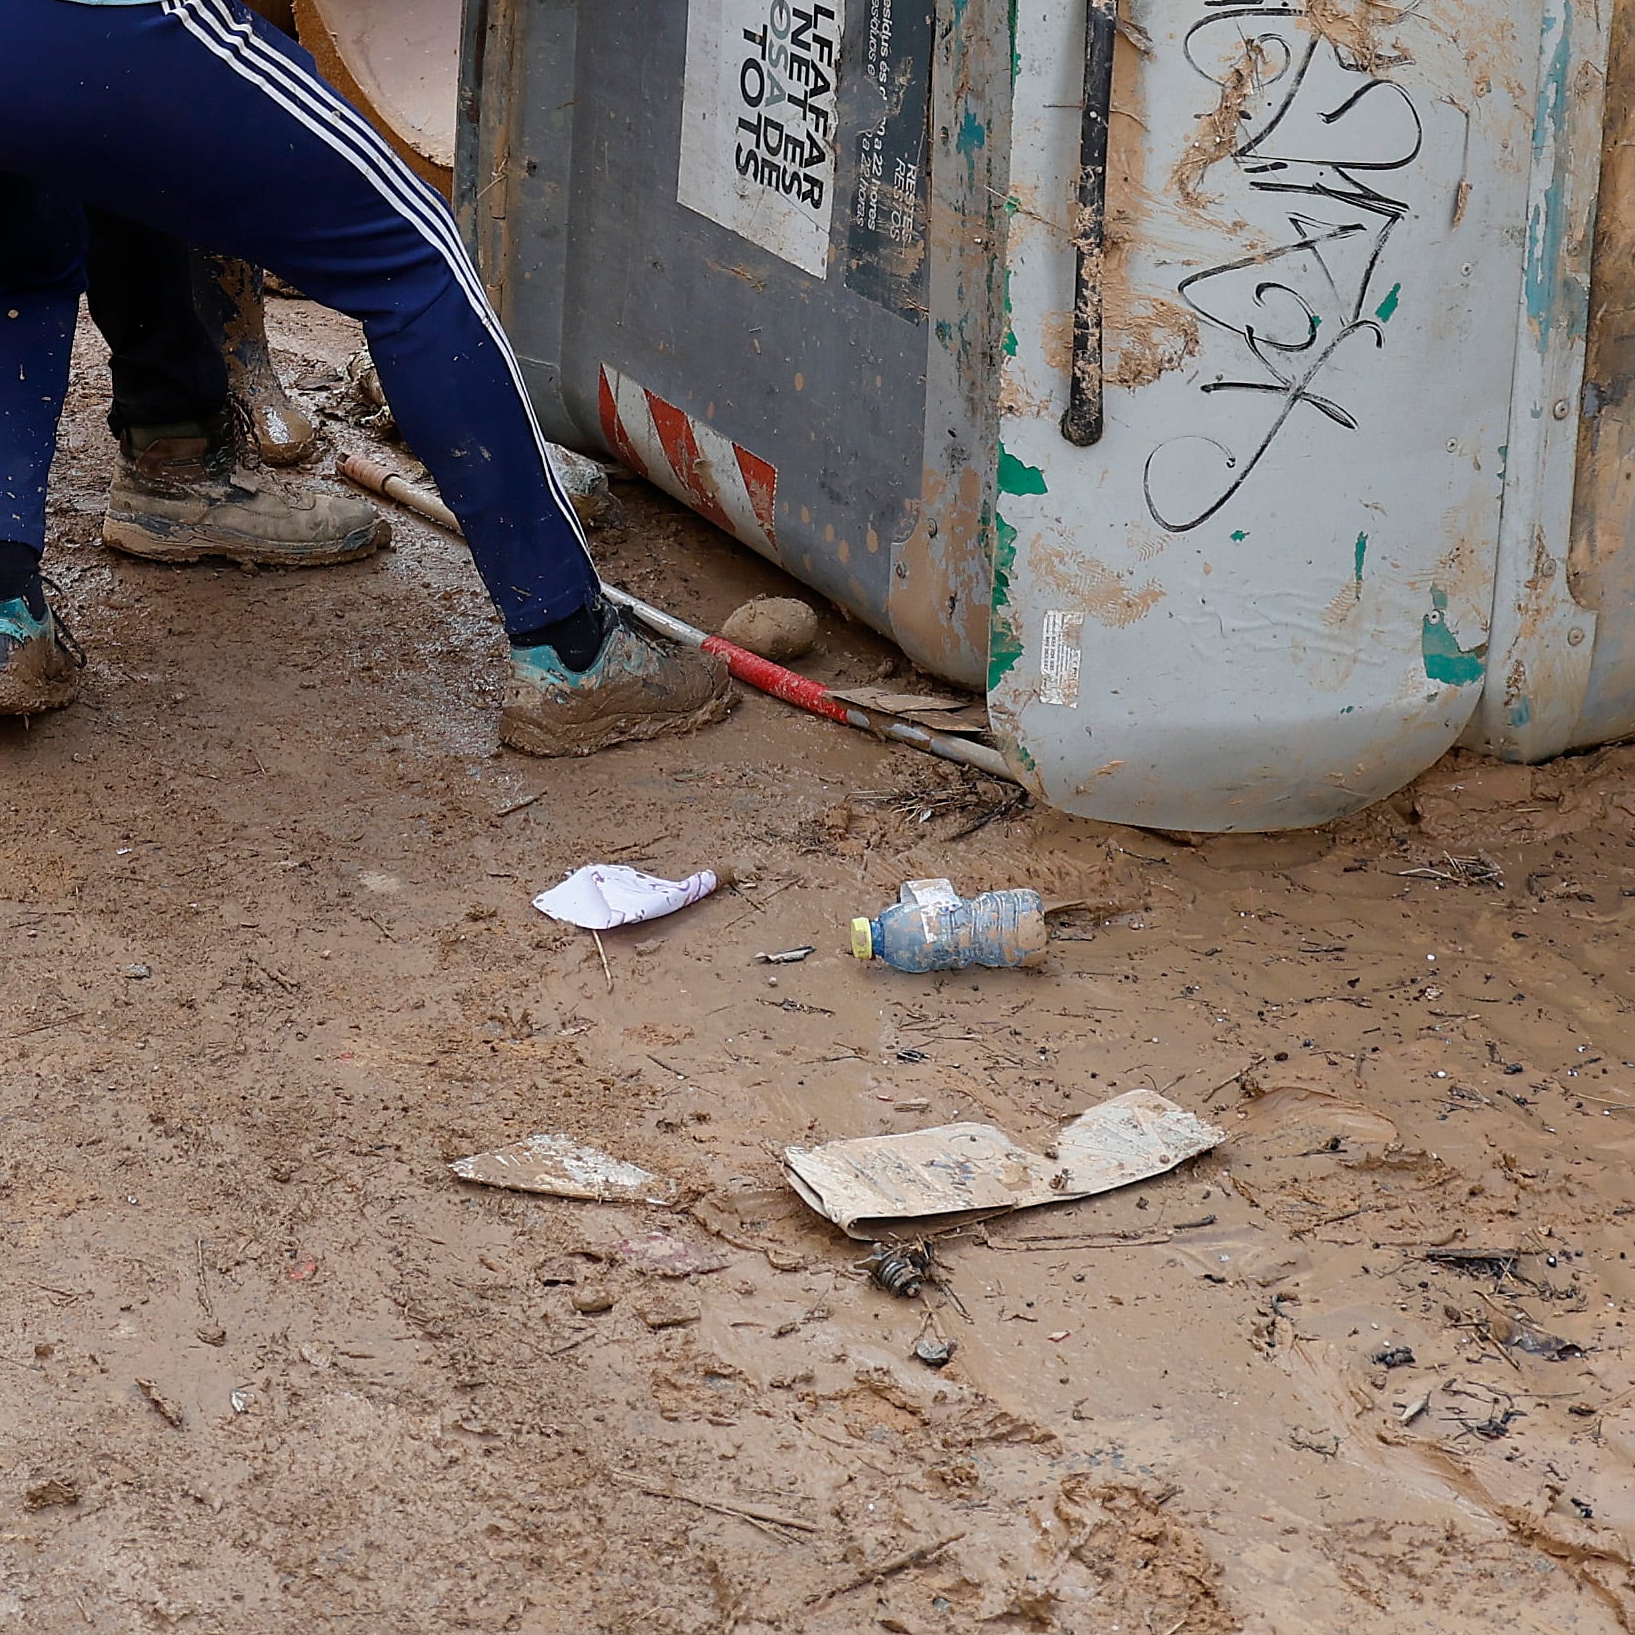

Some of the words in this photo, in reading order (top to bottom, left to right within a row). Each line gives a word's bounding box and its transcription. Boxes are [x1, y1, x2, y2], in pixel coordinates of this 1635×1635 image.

[788, 7, 813, 121] NET
[736, 24, 768, 183] TOTS
[760, 116, 785, 193] DE
[782, 134, 806, 200] ES
[860, 152, 872, 177] 22
[871, 151, 883, 176] 22
[855, 176, 870, 227] horas
